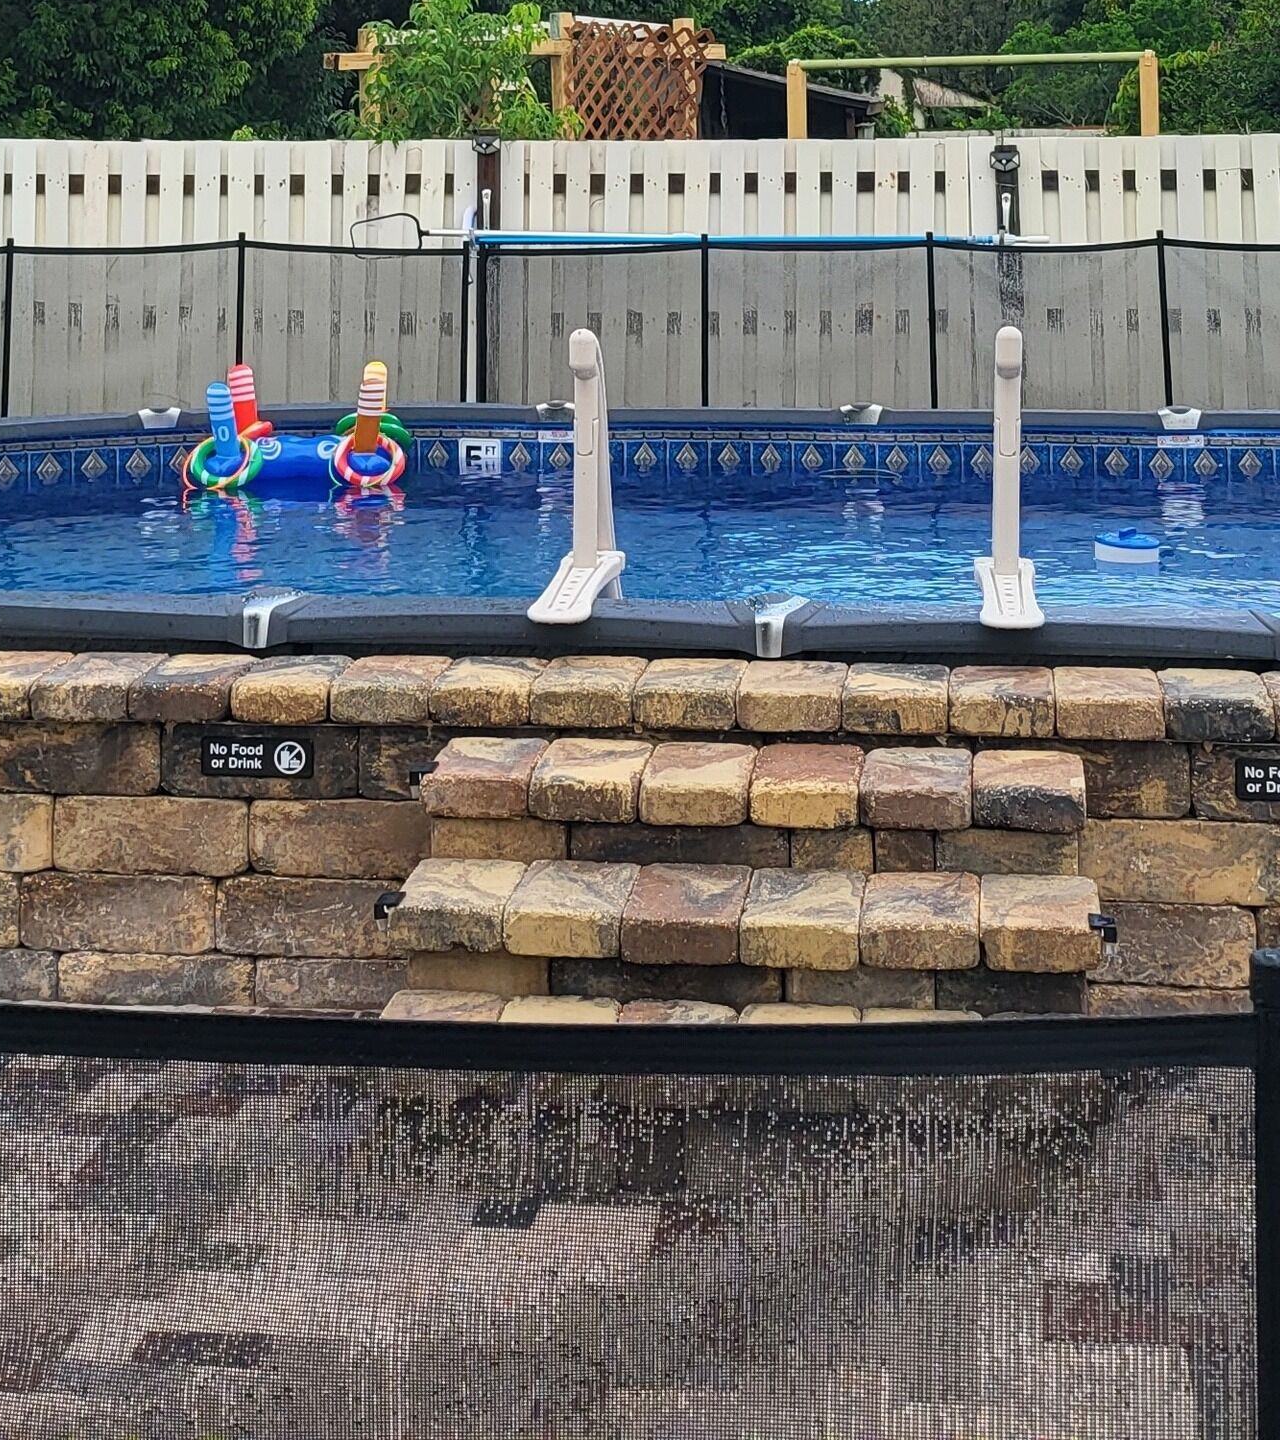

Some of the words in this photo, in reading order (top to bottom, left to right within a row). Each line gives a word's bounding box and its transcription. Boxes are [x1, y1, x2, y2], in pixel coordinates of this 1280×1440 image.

[485, 445, 497, 456] FT
[210, 743, 228, 756] No
[231, 744, 264, 757] Food
[211, 758, 225, 769] or
[228, 757, 263, 769] Drink
[1244, 766, 1265, 779] No
[1246, 783, 1262, 793] or
